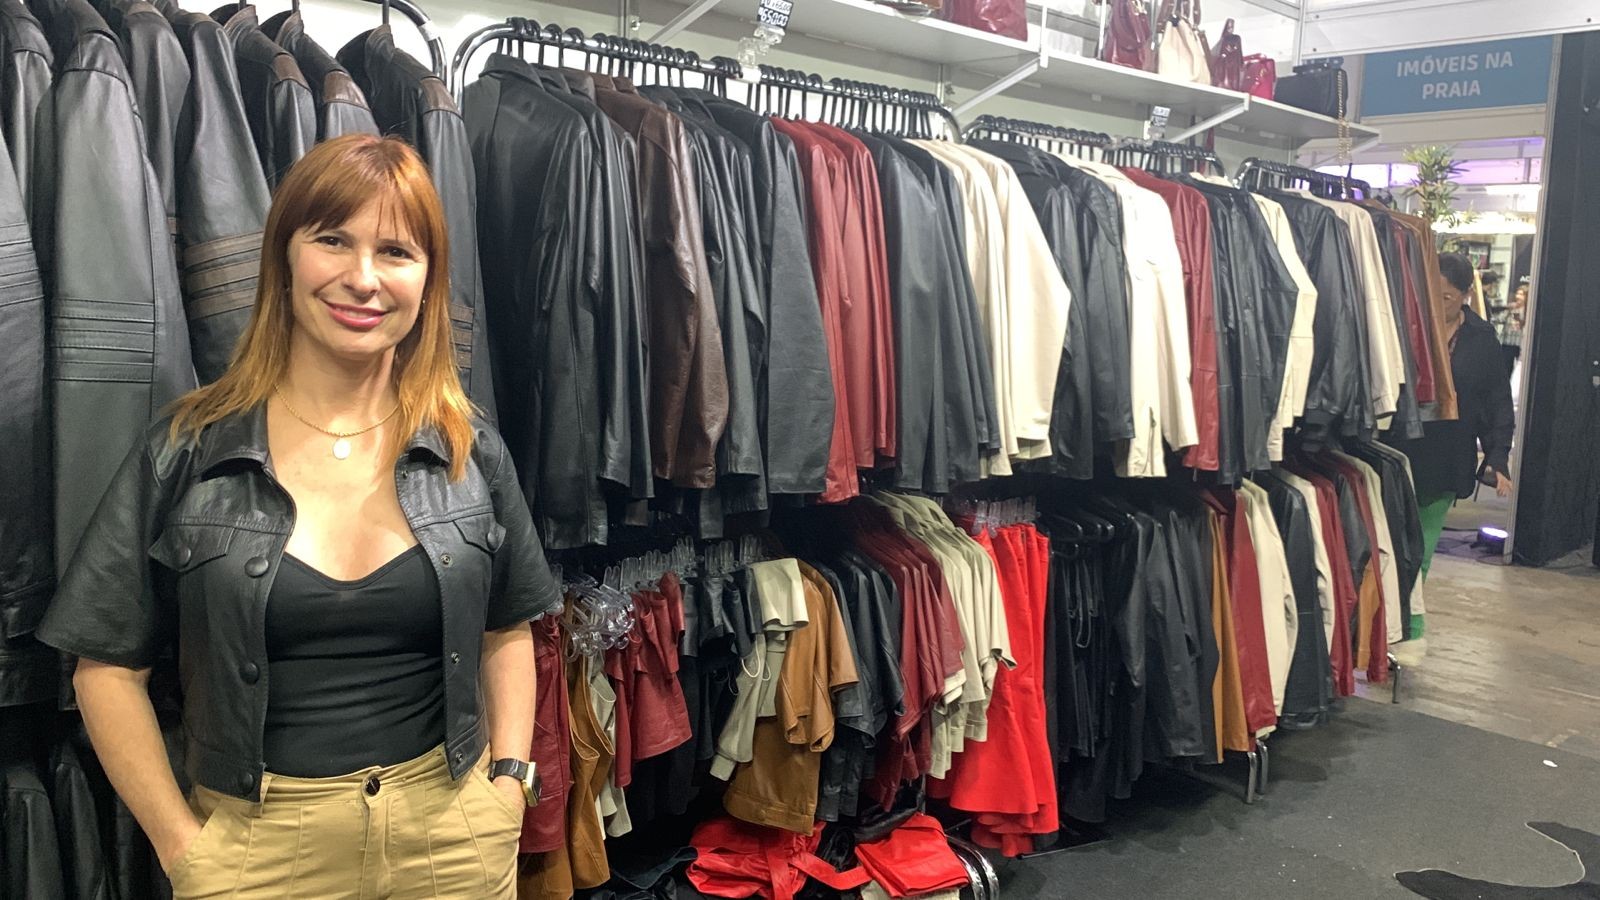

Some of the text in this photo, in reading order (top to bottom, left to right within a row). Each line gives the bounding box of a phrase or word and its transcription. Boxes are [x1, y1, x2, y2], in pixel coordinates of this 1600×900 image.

[1397, 51, 1513, 77] IMÓVEIS NA
[1422, 80, 1481, 99] PRAIA
